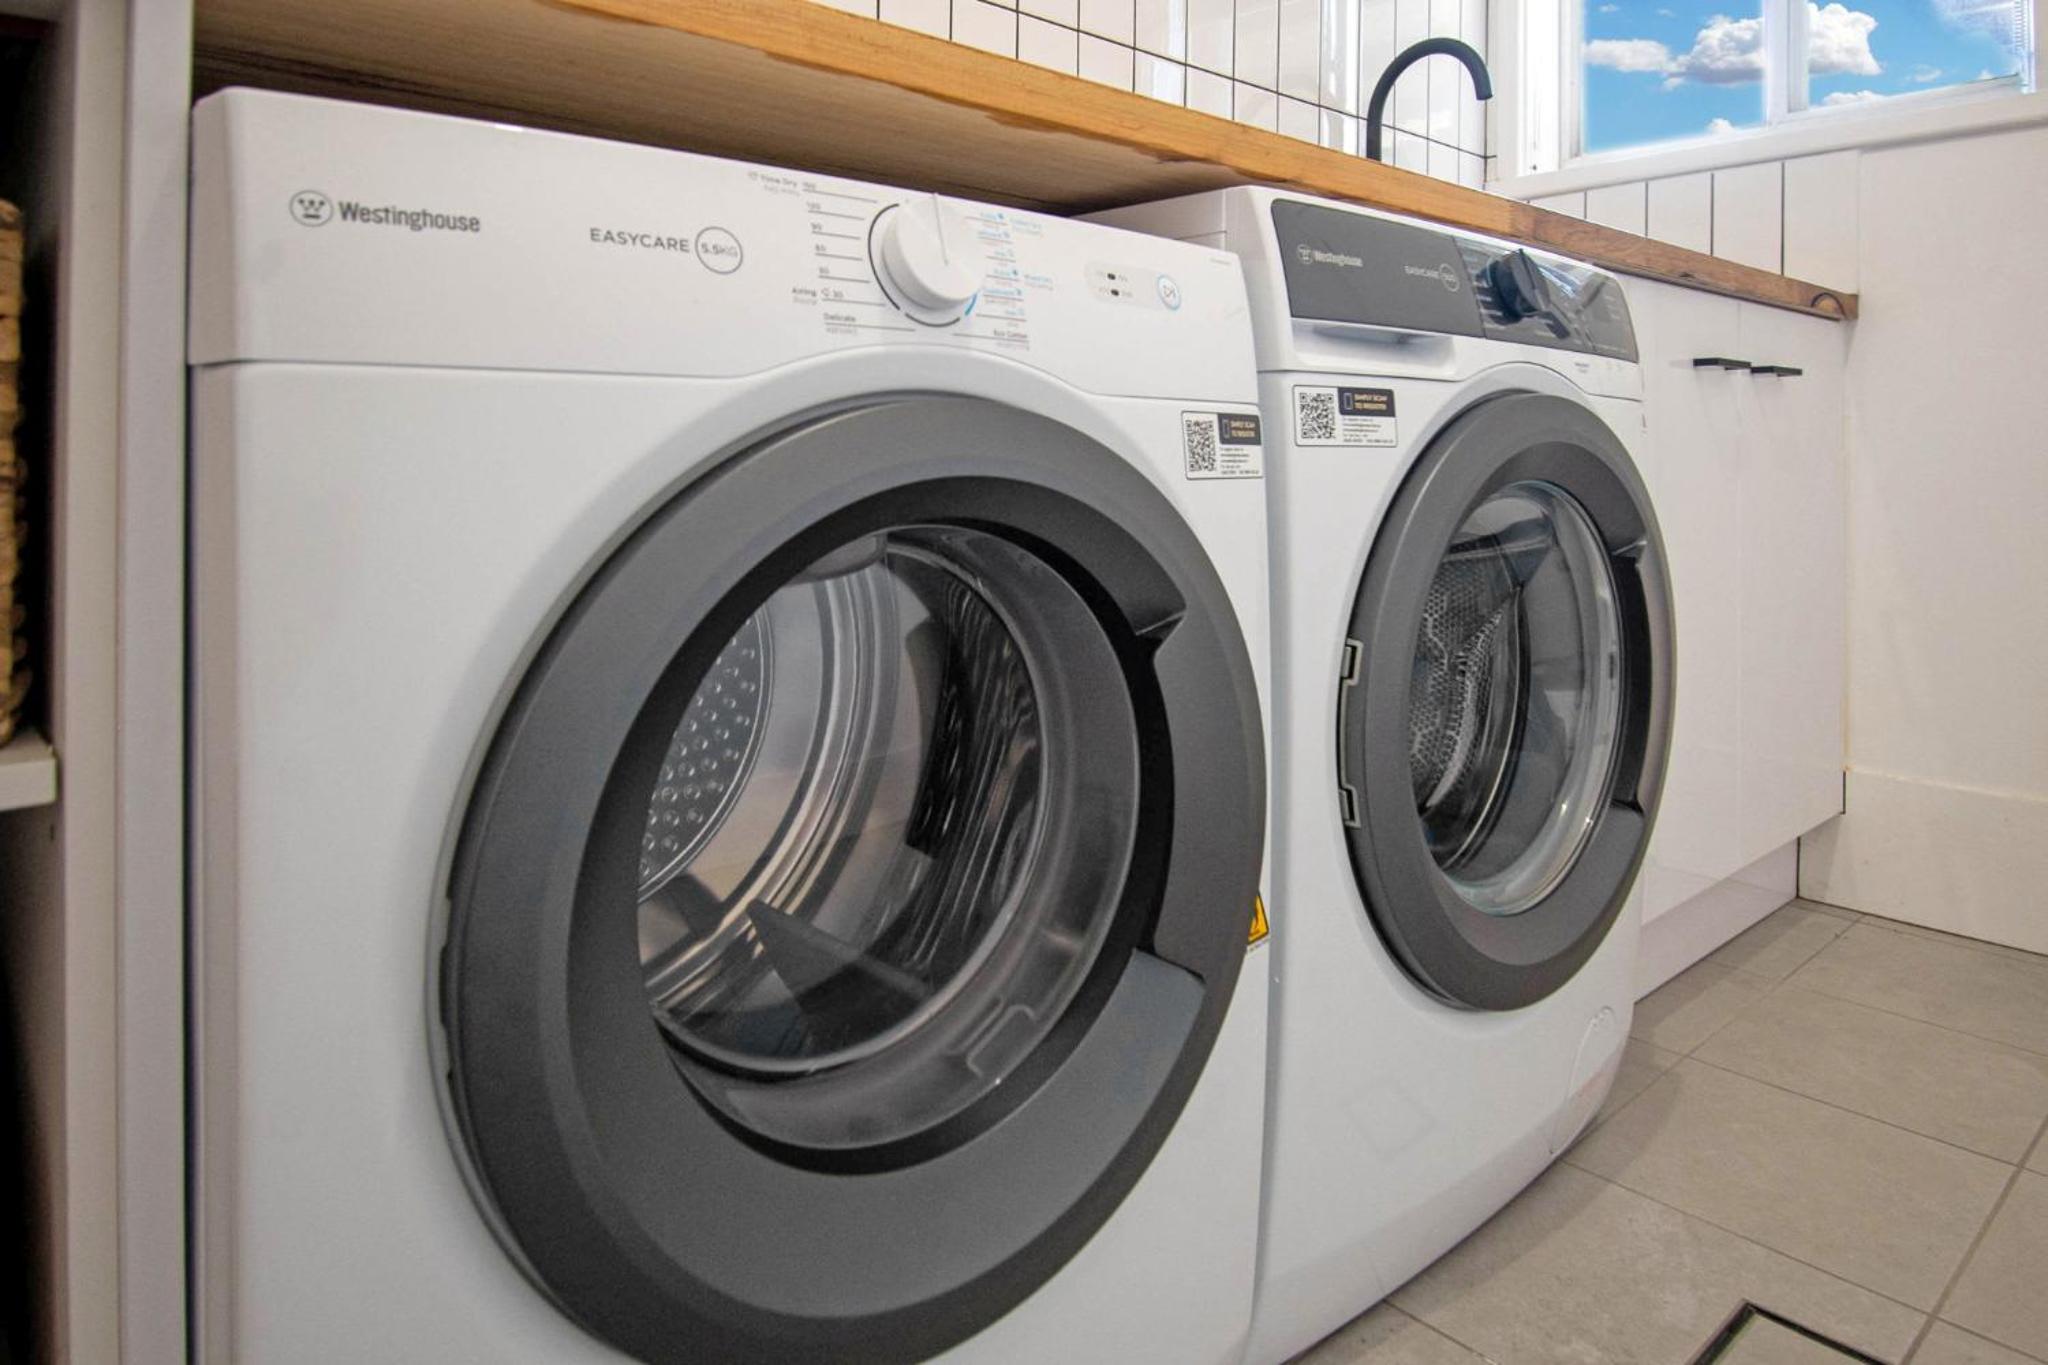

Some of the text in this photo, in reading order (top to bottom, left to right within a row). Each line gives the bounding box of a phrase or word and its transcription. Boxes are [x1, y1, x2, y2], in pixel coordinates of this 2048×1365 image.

[338, 200, 481, 233] Westinghouse
[589, 227, 690, 253] EASYCARE
[1312, 249, 1364, 268] Westinghouse
